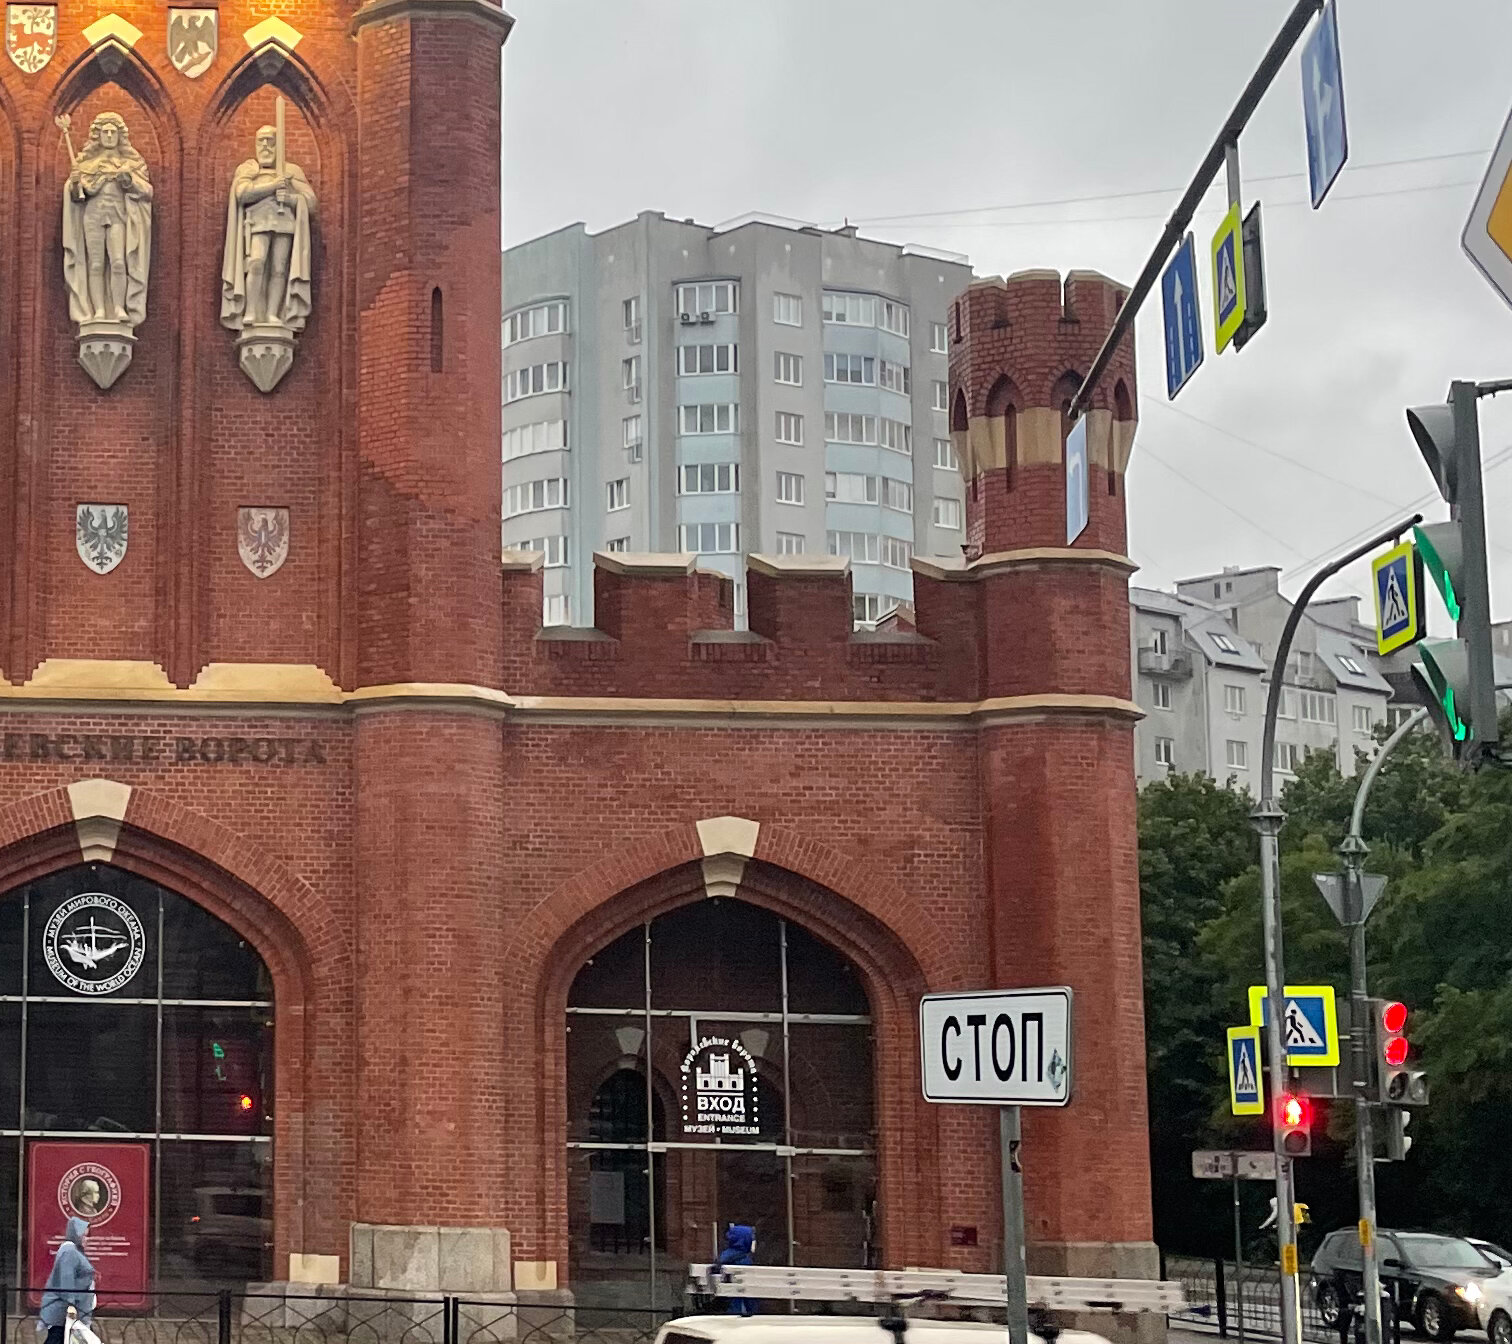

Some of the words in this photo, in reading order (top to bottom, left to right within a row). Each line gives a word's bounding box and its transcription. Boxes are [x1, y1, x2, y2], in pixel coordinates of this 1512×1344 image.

[174, 736, 327, 764] ВОРОТА
[66, 896, 118, 912] МИРОВОГО
[117, 905, 141, 941] ОКЕАНА
[46, 945, 68, 981] MUSEUM
[66, 977, 78, 987] OF
[79, 983, 95, 993] THE
[95, 974, 126, 992] WORLD
[123, 947, 142, 977] OCEAN
[941, 1012, 1044, 1083] СТОП
[697, 1096, 746, 1114] ВХОД
[697, 1113, 746, 1123] ENTRANCE
[721, 1126, 760, 1134] MUSEUM
[61, 1168, 79, 1206] ИСТОРИЯ
